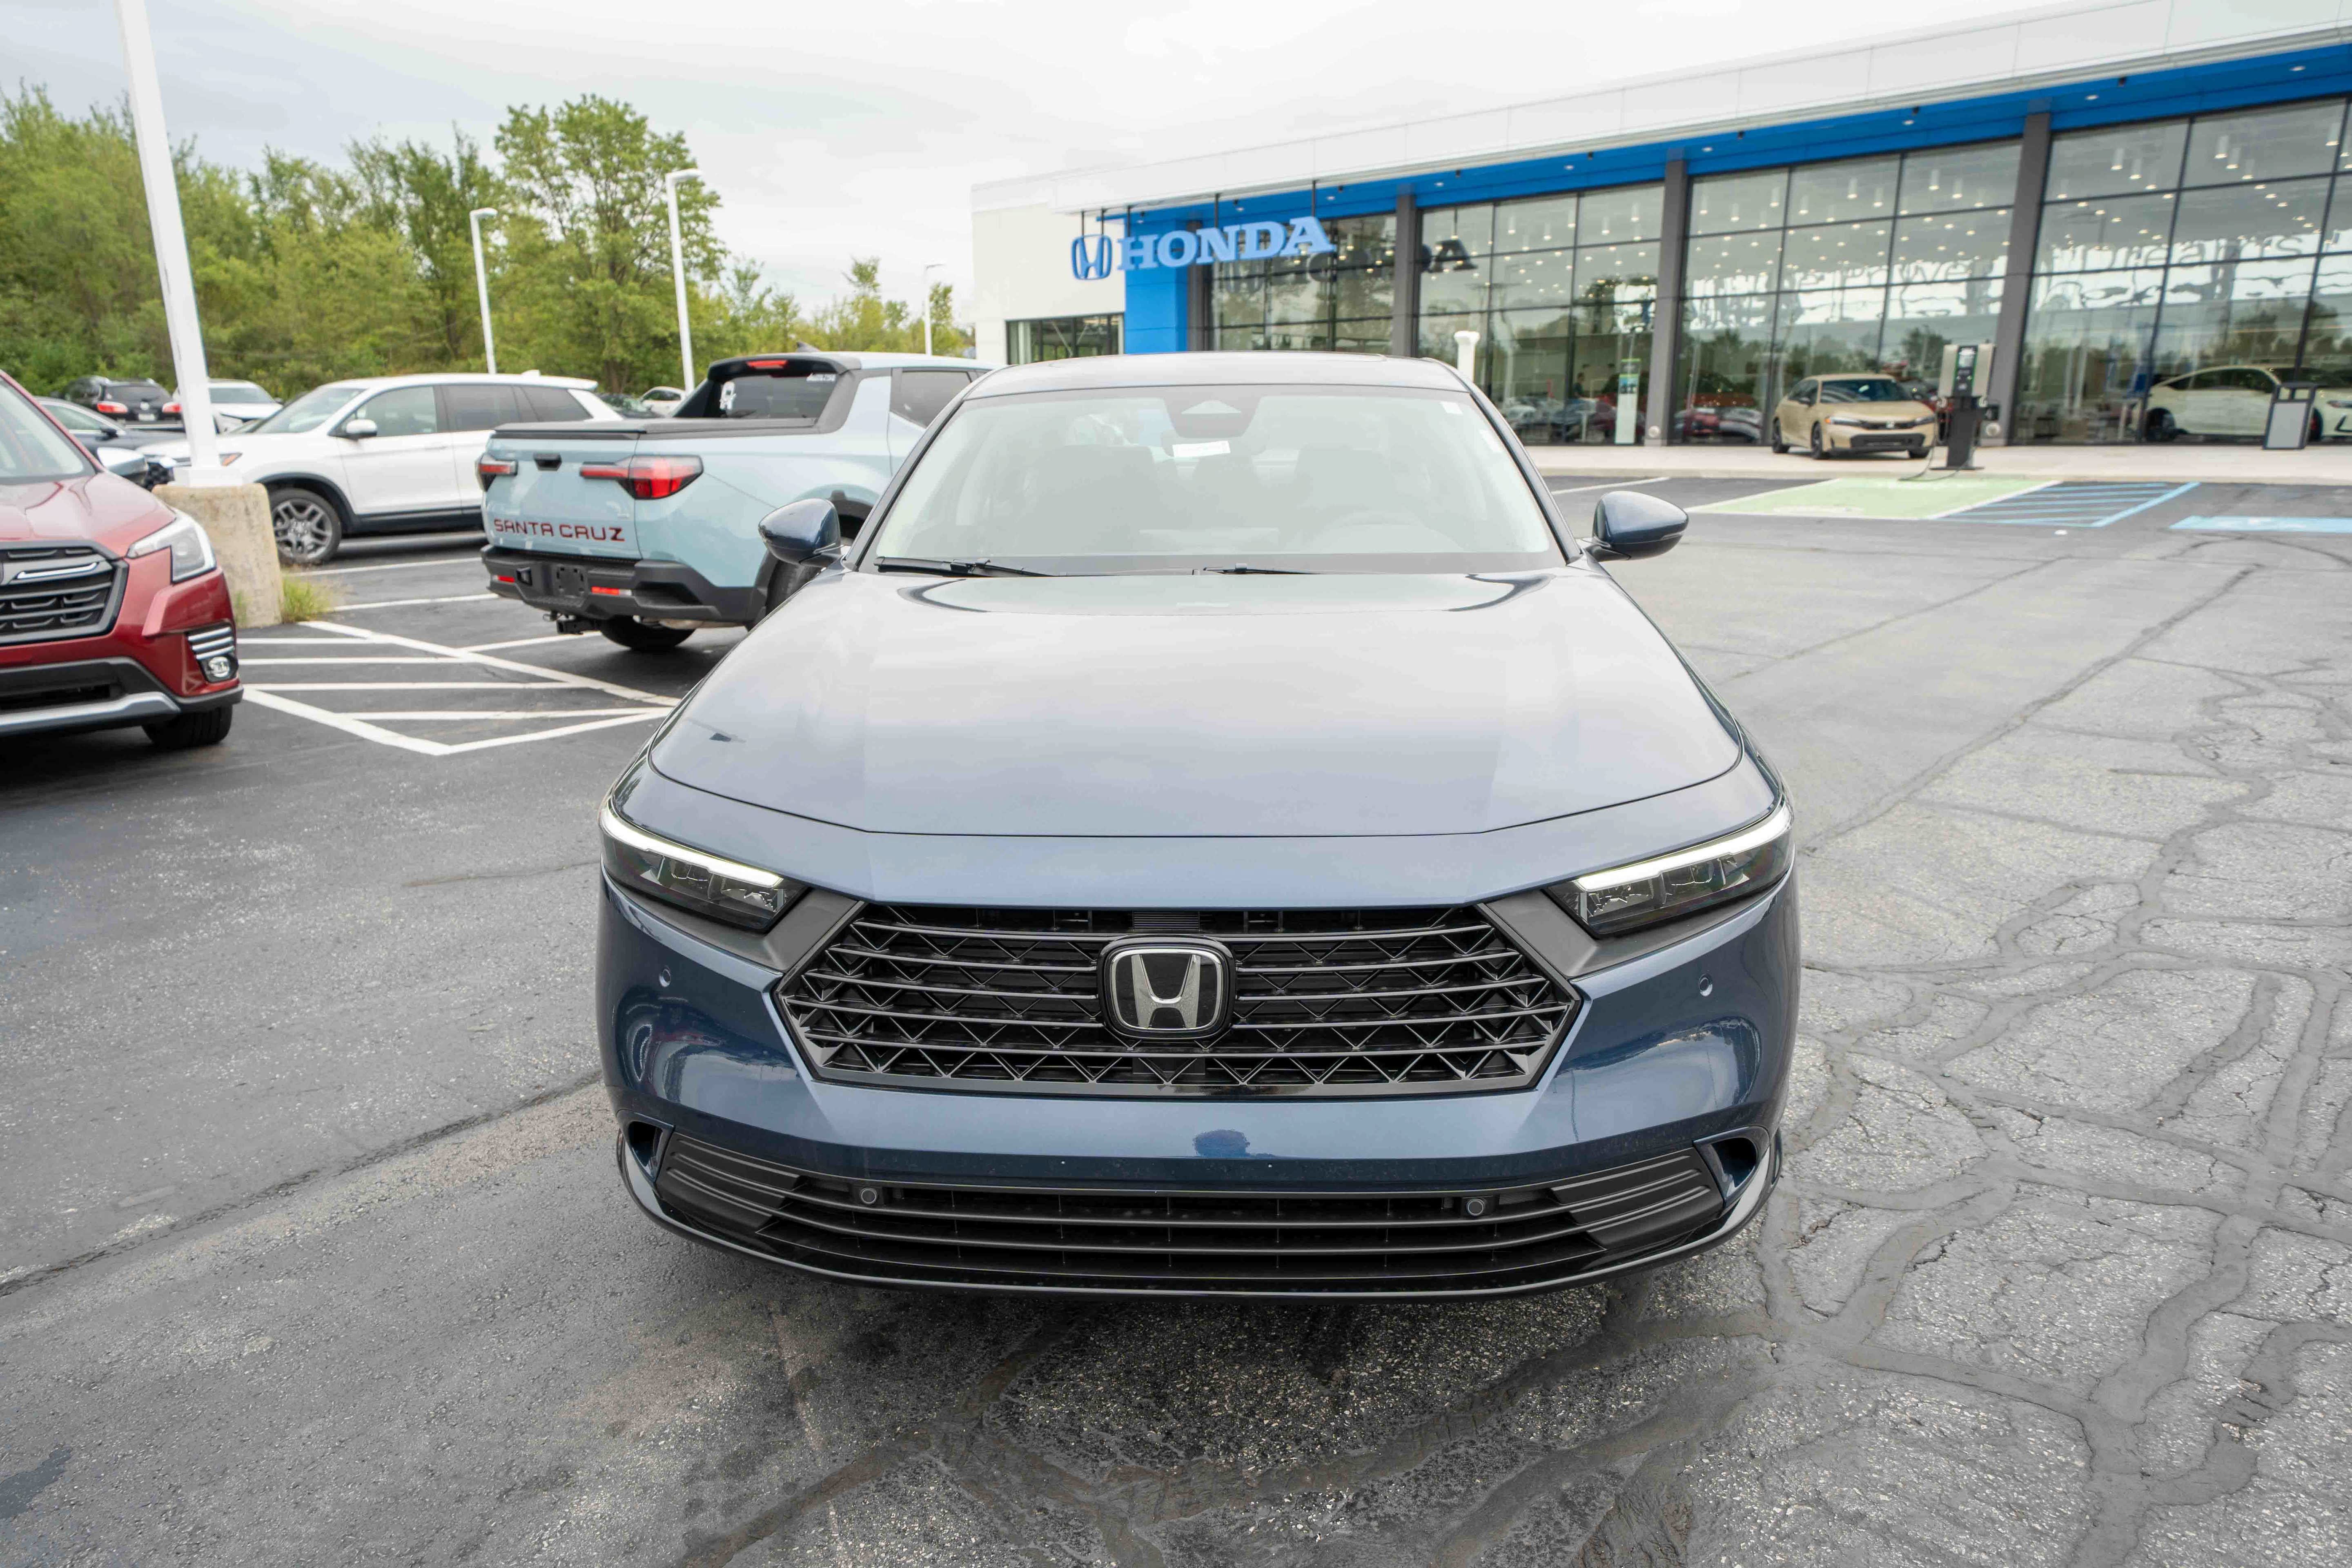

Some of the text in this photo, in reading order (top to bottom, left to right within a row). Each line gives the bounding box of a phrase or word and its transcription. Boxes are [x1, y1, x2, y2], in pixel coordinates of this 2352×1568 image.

[1117, 216, 1336, 271] HONDA
[494, 519, 625, 542] SANTA CRUZ
